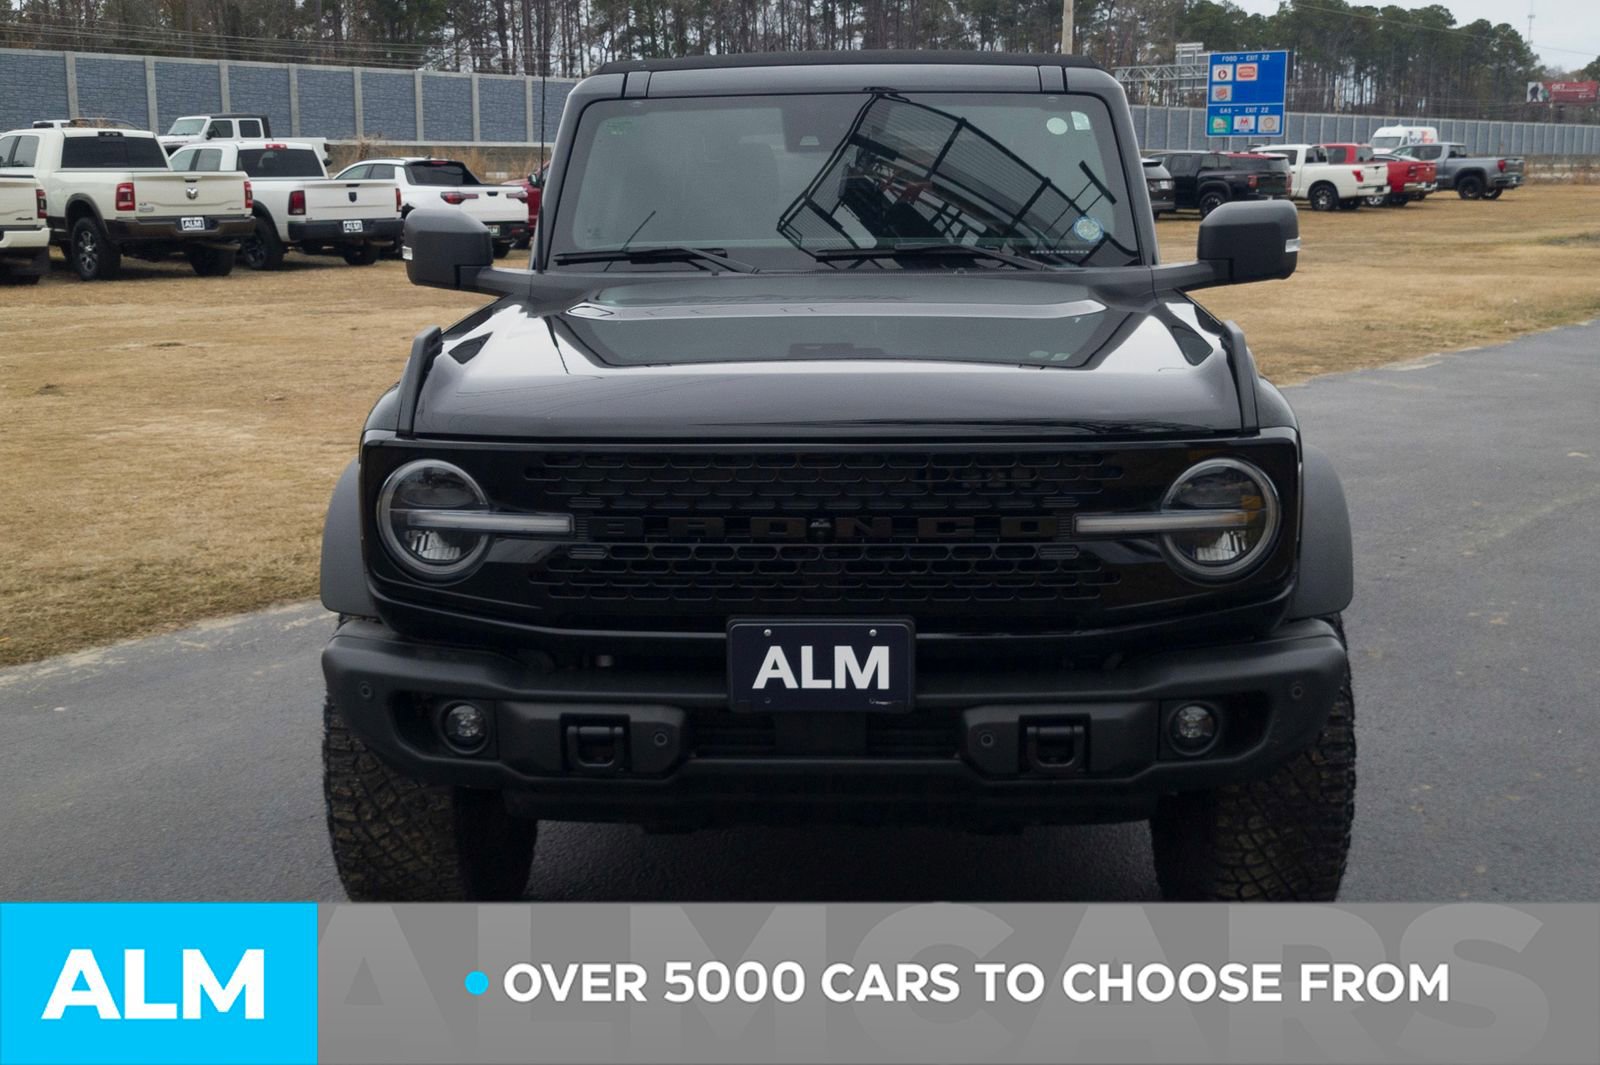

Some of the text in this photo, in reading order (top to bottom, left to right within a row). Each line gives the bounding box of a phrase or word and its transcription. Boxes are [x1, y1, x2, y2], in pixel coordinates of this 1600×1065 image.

[184, 220, 202, 228] ALM
[588, 516, 1057, 539] BRONCO
[752, 645, 890, 690] ALM
